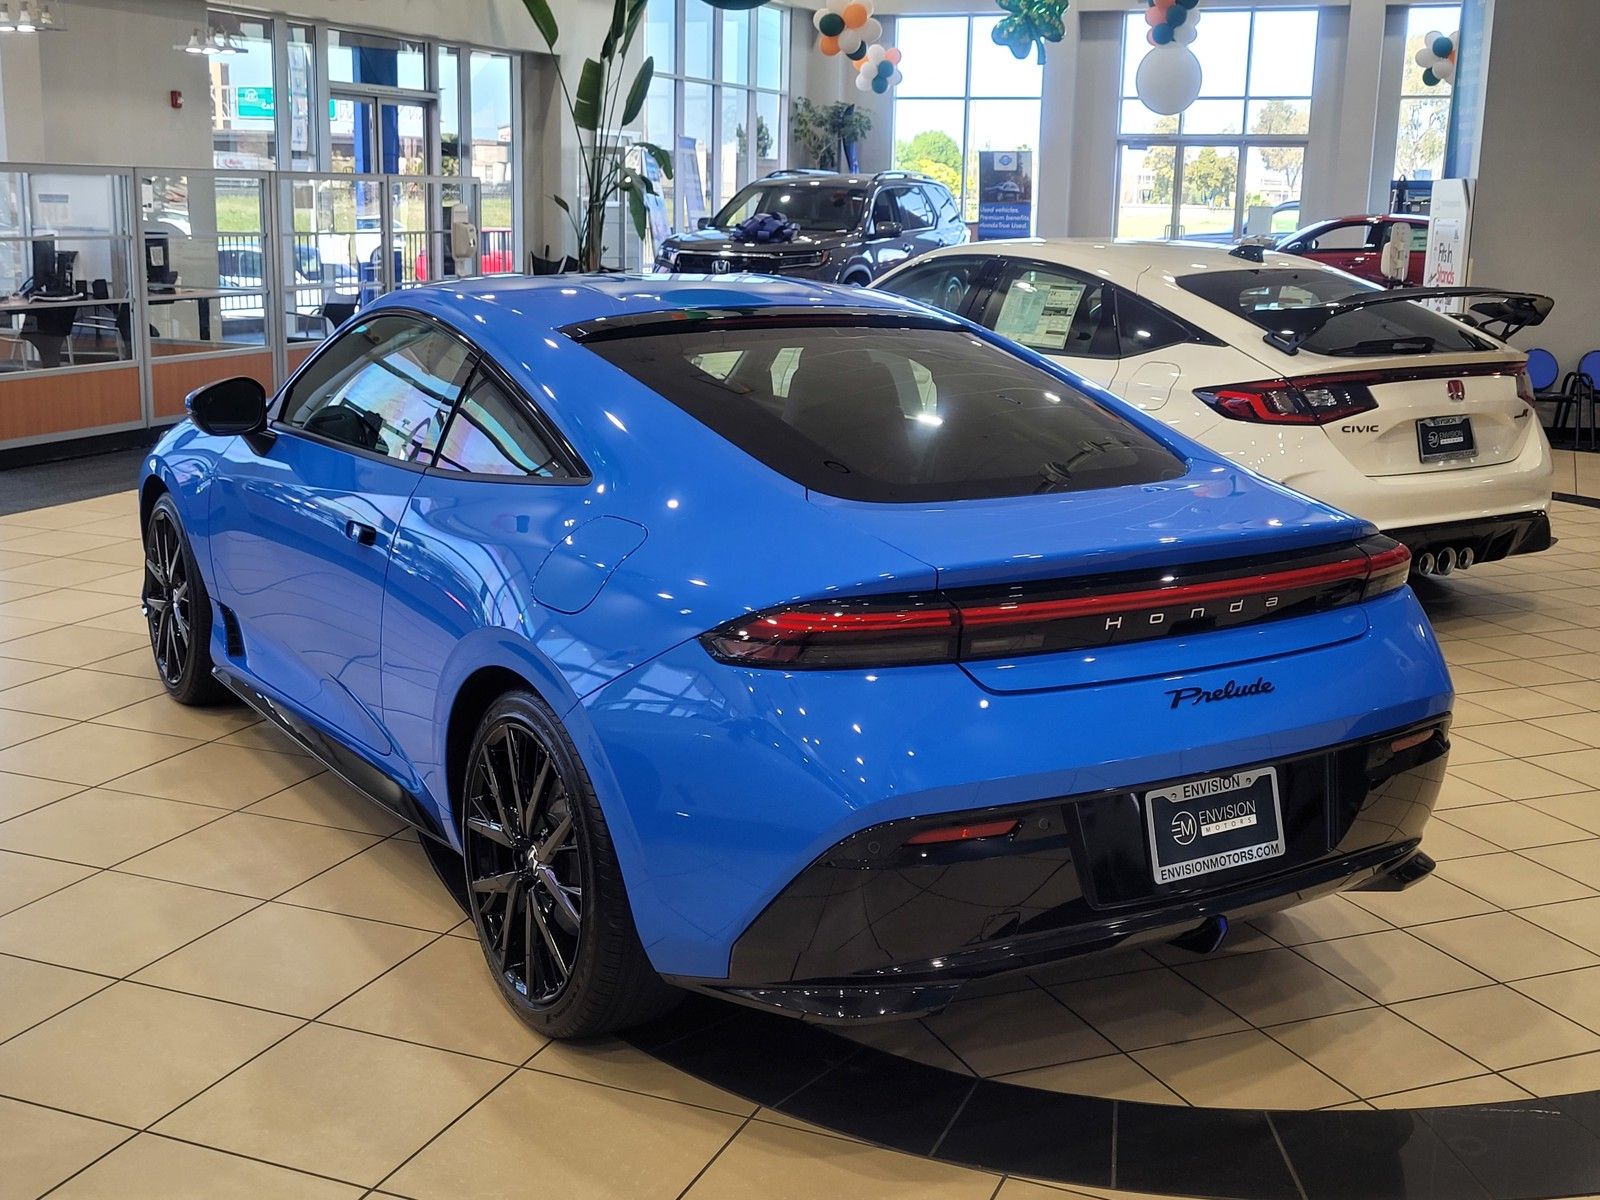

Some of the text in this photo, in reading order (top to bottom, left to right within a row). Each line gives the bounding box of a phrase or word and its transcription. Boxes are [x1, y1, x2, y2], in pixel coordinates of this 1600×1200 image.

[1341, 425, 1379, 433] CIVIC
[1104, 596, 1279, 631] Honda
[1164, 677, 1276, 710] Prelude
[1183, 775, 1241, 799] ENVISION
[1199, 800, 1257, 825] ENVISION
[1205, 816, 1253, 833] MOTORS
[1161, 843, 1281, 881] ENVISIONMOTORS.COM
